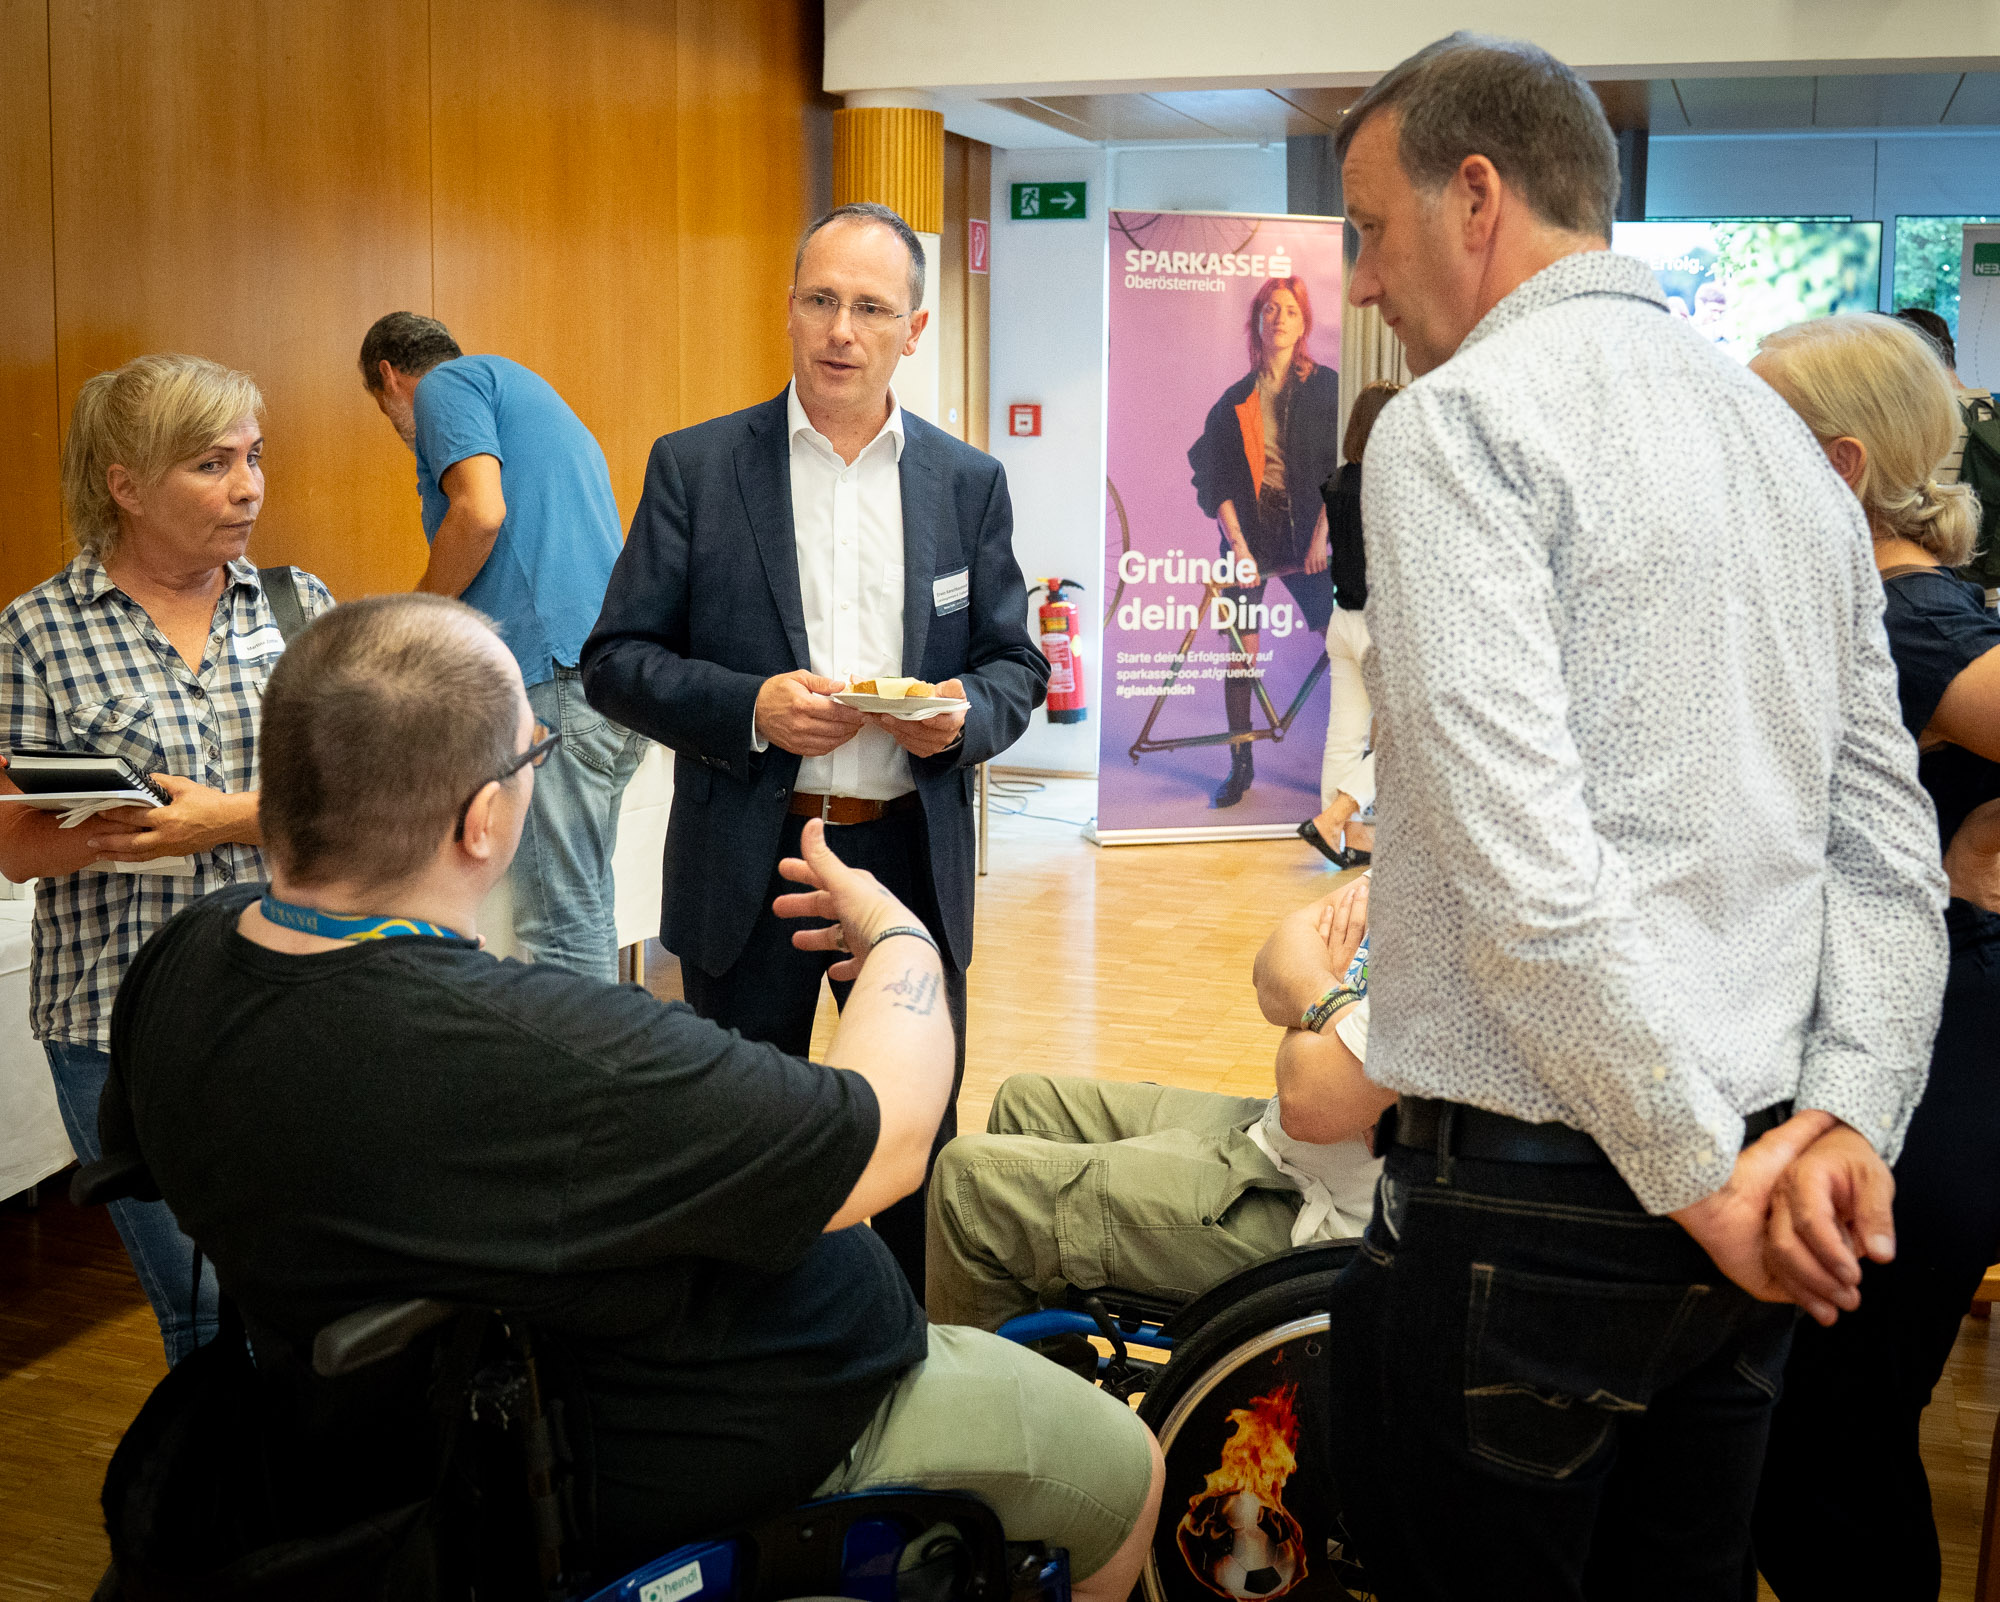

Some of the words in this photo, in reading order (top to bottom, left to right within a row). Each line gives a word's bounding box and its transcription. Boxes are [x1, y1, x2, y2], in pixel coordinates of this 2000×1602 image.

[1125, 249, 1266, 277] SPARKASSE
[1124, 274, 1226, 292] Oberösterreich
[1117, 549, 1257, 585] Gründe
[1117, 596, 1199, 631] dein
[1210, 595, 1304, 638] Ding.
[1116, 652, 1151, 664] Starte
[1153, 651, 1185, 663] deine
[1187, 651, 1254, 665] Erfolgsstory
[1256, 650, 1274, 662] auf
[1116, 667, 1266, 682] sparkasse-ooe.at/gruender
[1115, 684, 1196, 698] #glaubandich
[1326, 992, 1353, 1014] JAHRE
[663, 1566, 698, 1596] heindl
